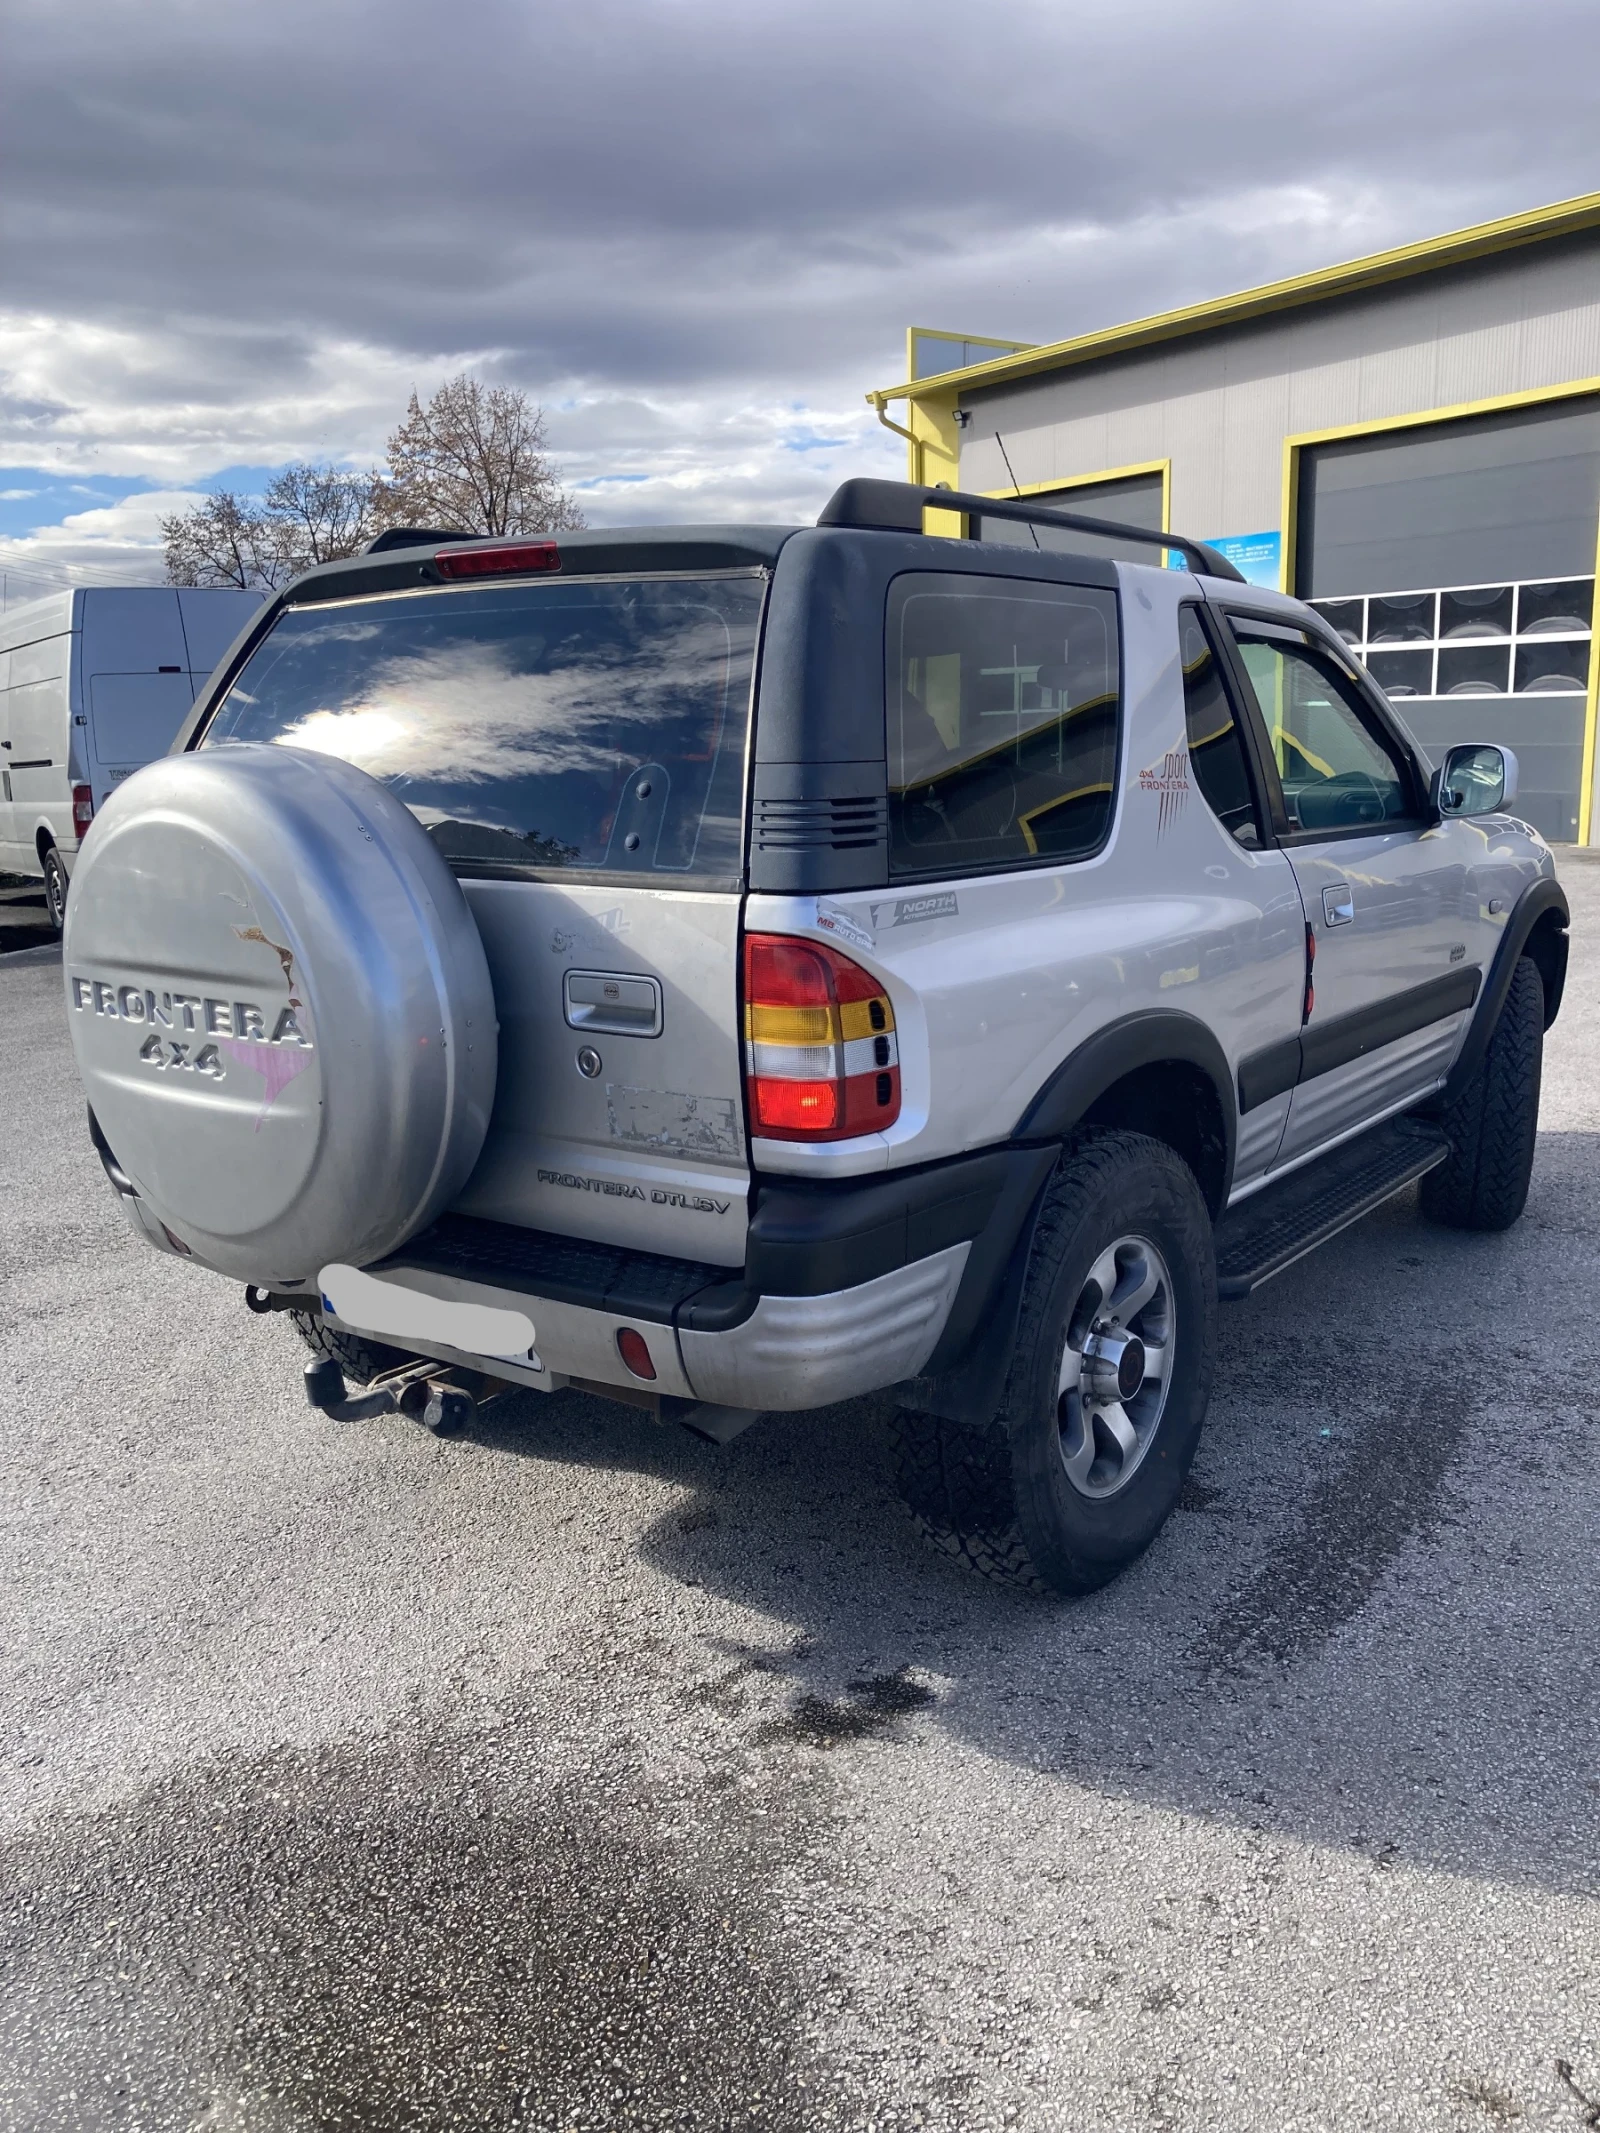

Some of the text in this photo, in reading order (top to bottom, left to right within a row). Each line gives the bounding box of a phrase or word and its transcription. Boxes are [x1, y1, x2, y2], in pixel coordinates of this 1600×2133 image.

[1140, 780, 1190, 791] FRONTERA
[902, 894, 956, 914] NORTH
[71, 976, 314, 1048] FRONTERA
[537, 1169, 646, 1201] FRONTERA
